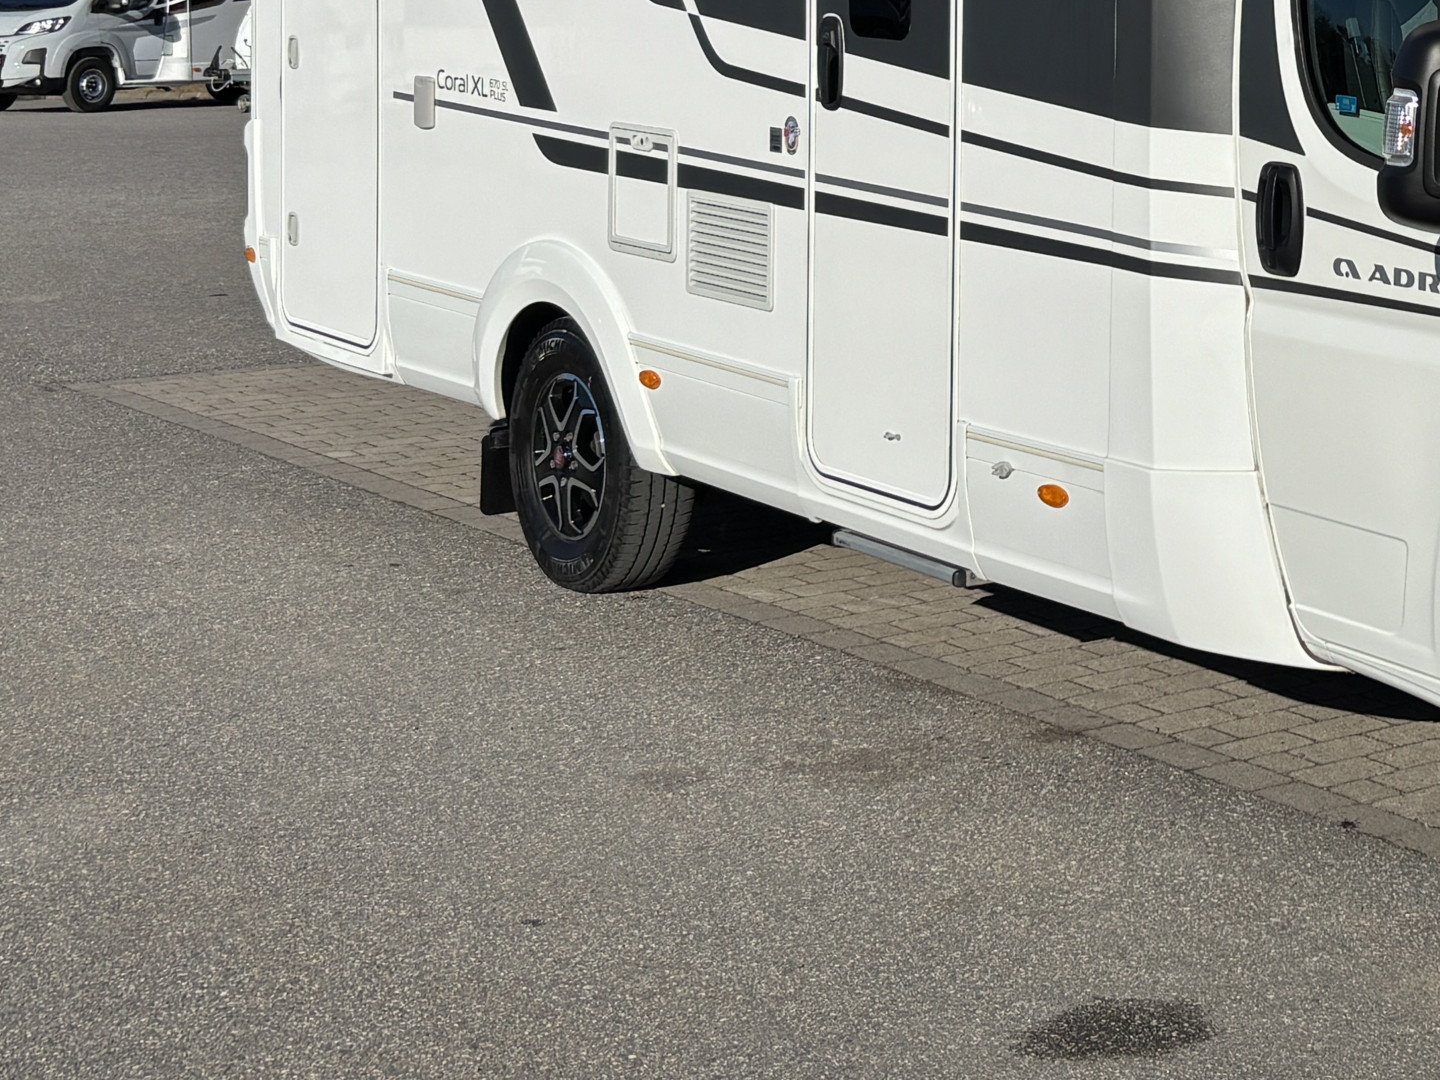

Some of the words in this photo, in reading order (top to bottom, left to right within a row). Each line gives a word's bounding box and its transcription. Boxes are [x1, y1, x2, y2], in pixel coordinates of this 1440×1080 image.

[437, 69, 469, 94] Coral
[471, 75, 488, 98] XL
[489, 89, 507, 103] PLUS
